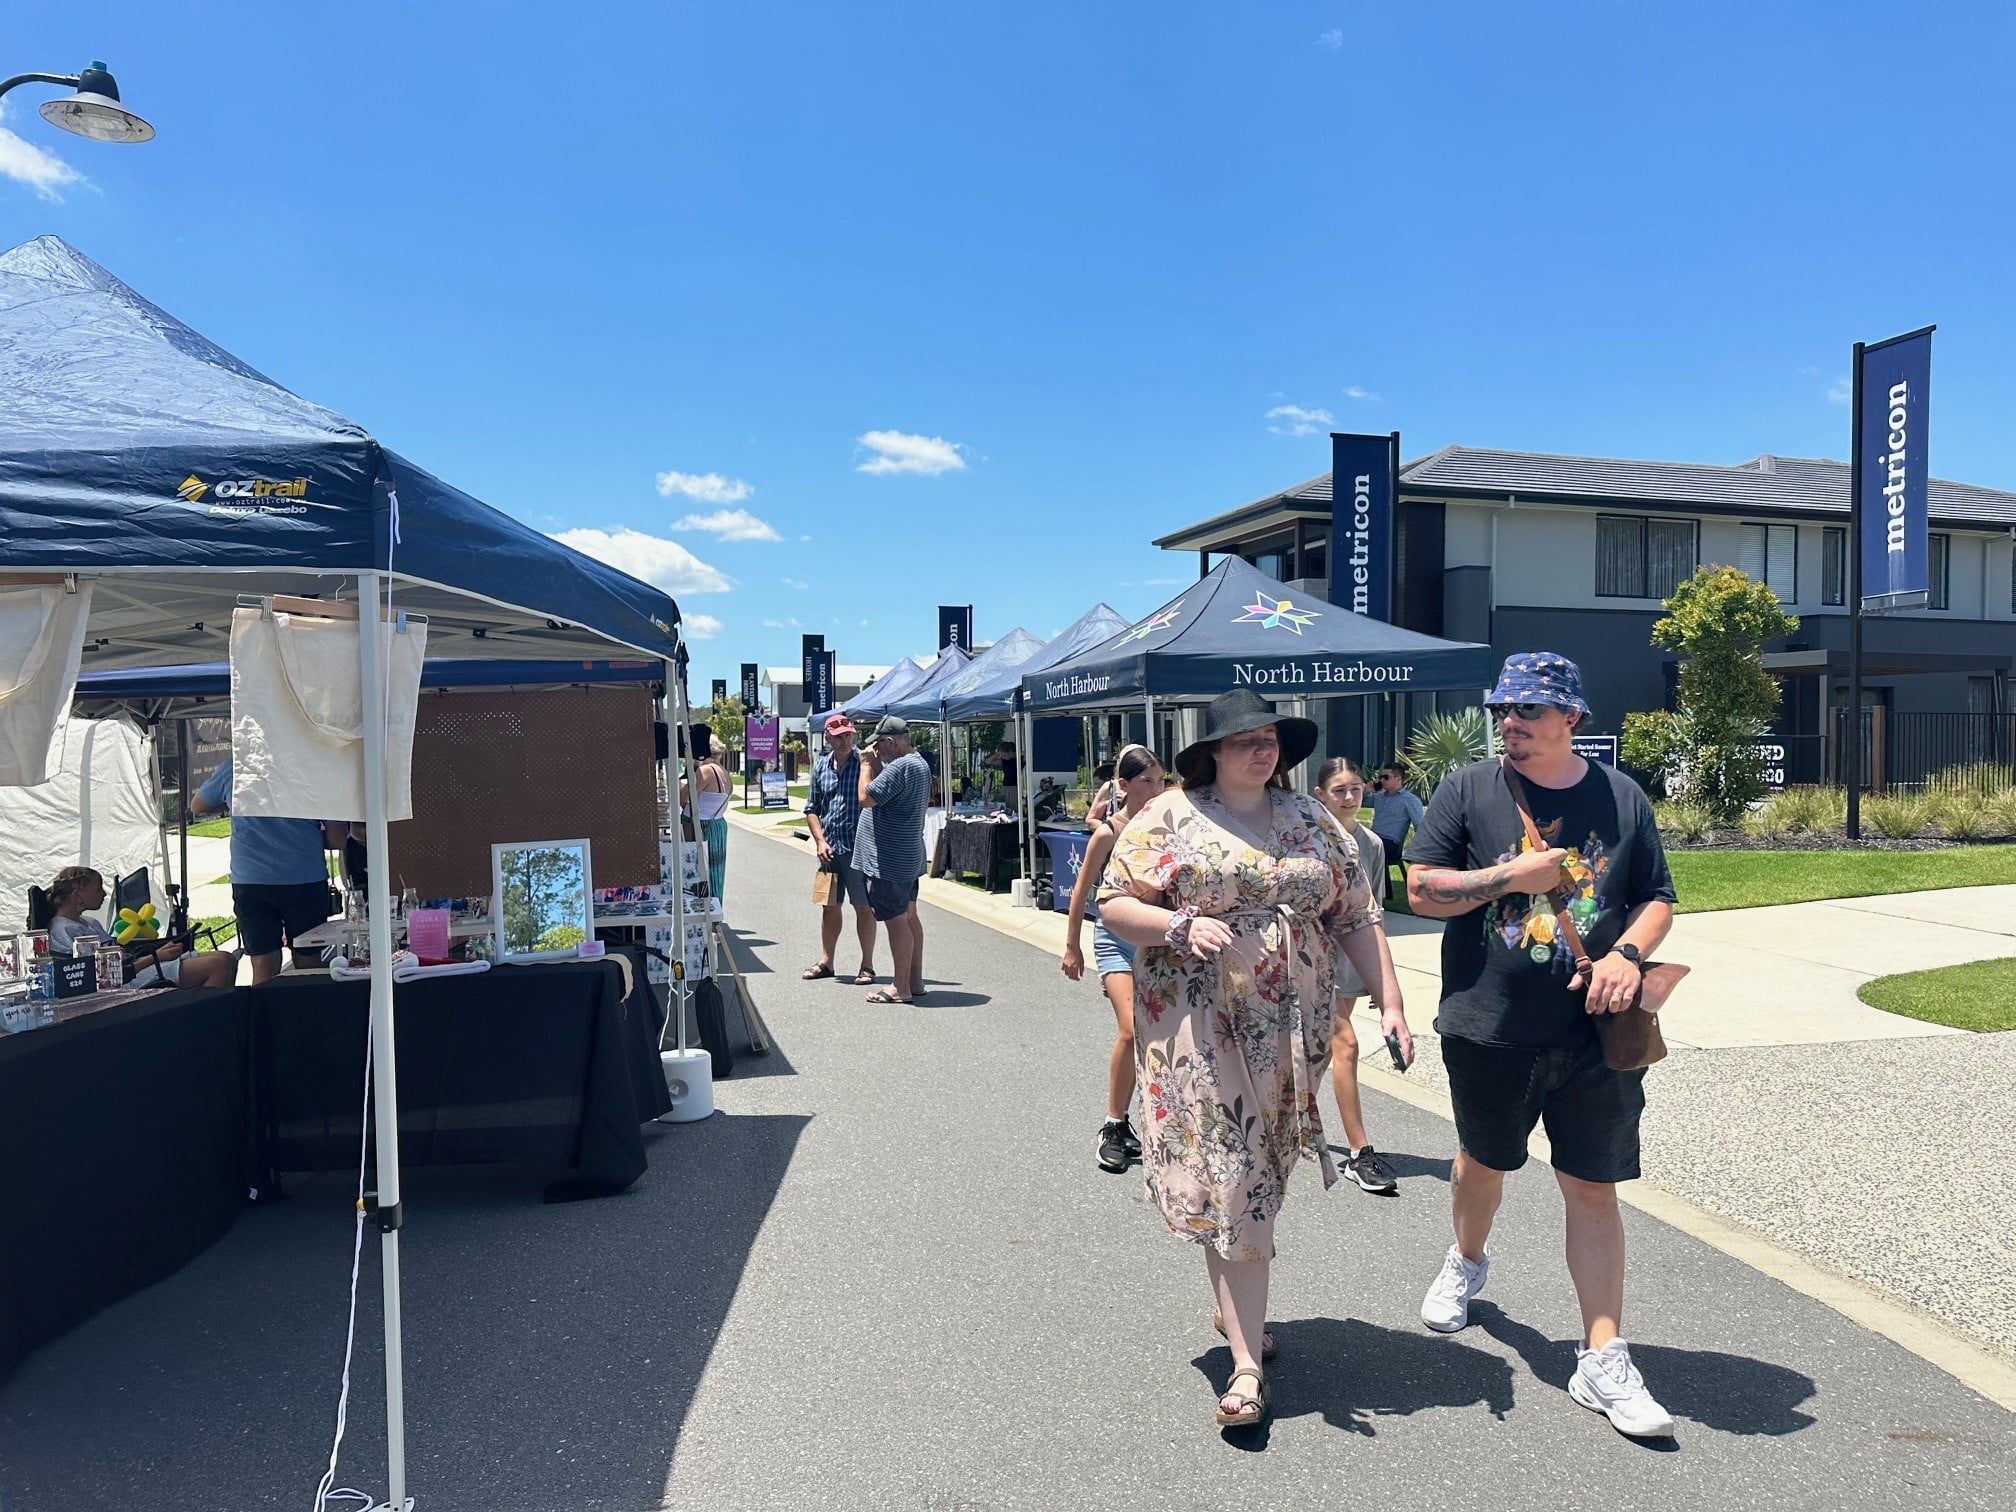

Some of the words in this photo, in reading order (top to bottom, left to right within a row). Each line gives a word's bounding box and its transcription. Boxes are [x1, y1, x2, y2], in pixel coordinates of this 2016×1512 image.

[1878, 380, 1907, 554] metricon
[1345, 473, 1370, 615] metricon
[817, 663, 826, 708] metricon
[1045, 677, 1070, 700] North
[1070, 672, 1110, 696] Harbour
[1232, 662, 1306, 685] North
[1311, 660, 1413, 683] Harbour
[62, 962, 86, 972] GLASS
